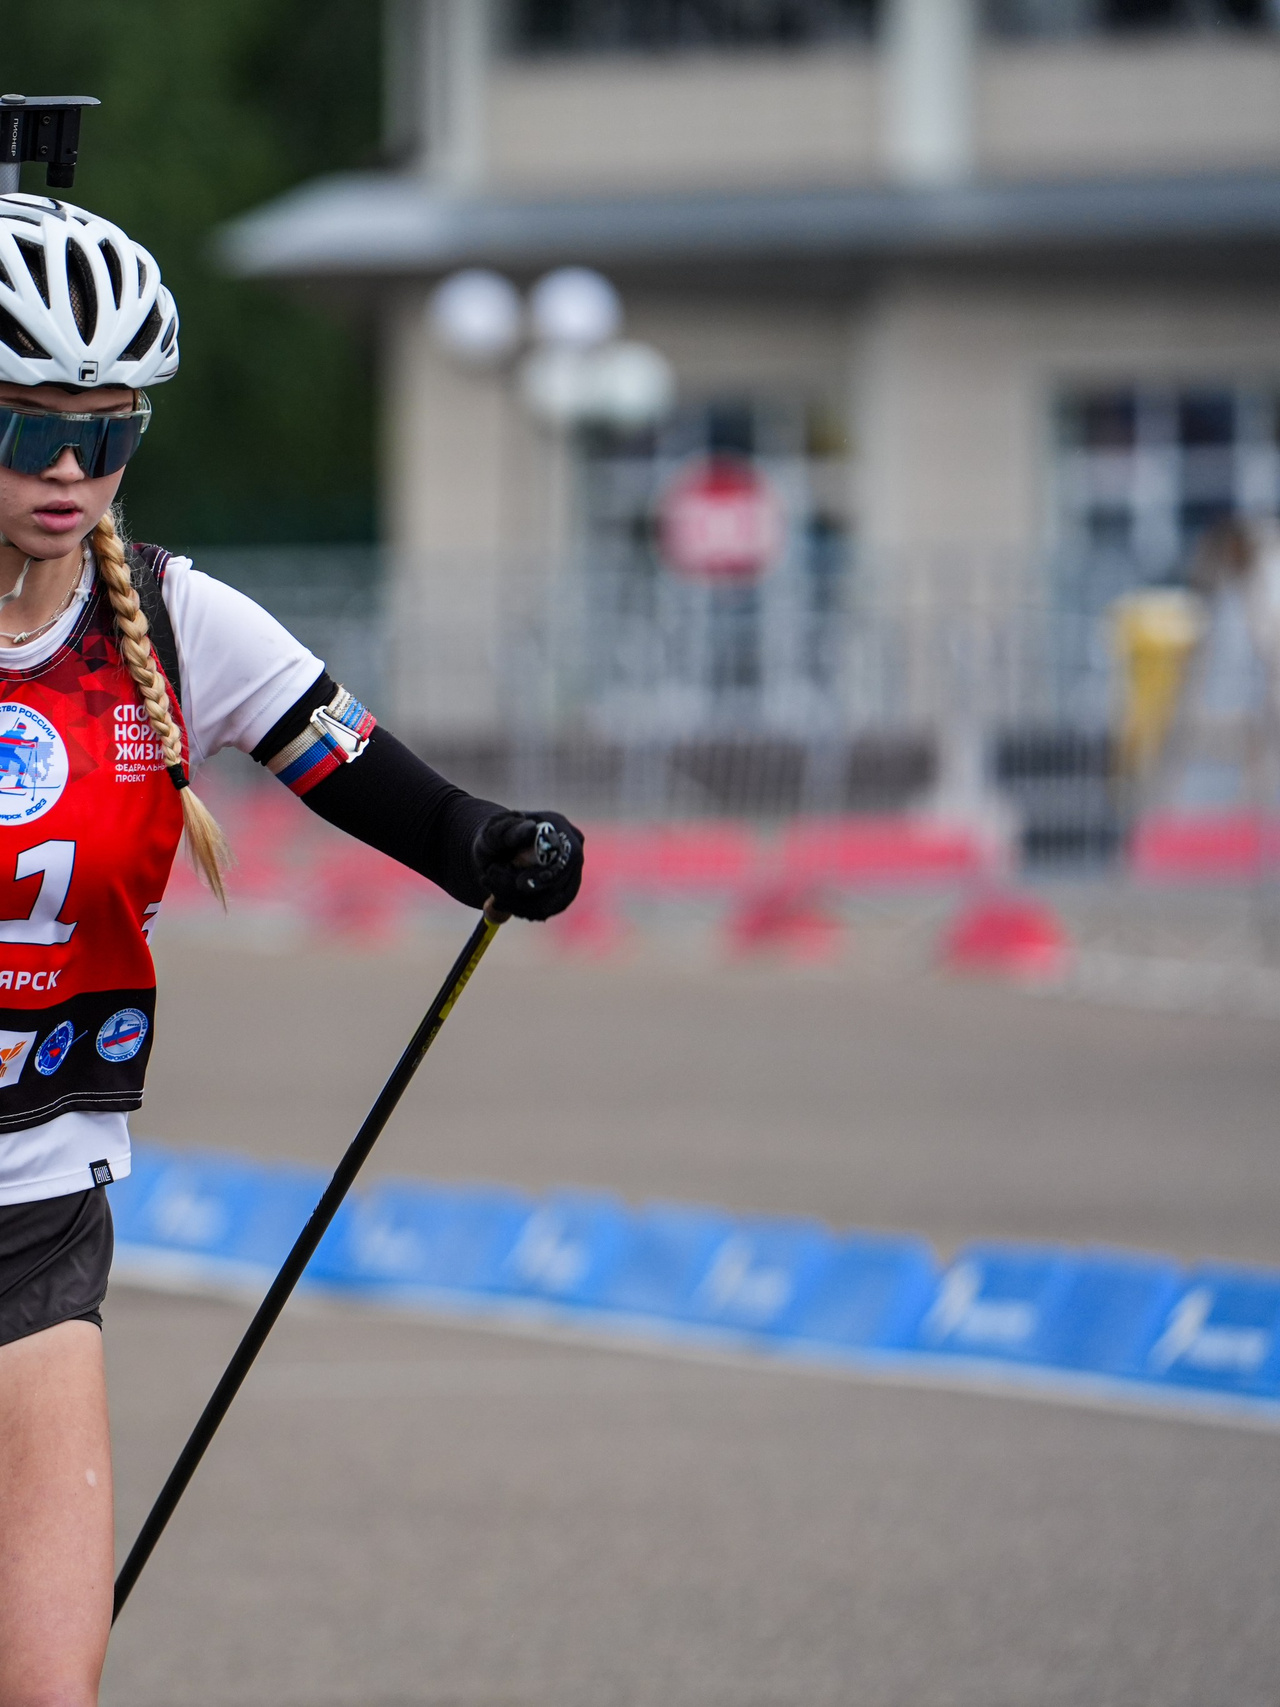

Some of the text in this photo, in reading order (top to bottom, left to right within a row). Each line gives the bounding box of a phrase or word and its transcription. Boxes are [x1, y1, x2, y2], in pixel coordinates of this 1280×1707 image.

[11, 118, 19, 157] ПИОНЕР
[113, 704, 149, 722] СПО
[18, 707, 57, 740] РОССИИ
[115, 743, 165, 760] ЖИЗН
[115, 774, 146, 783] ПРОЕКТ
[25, 797, 47, 817] 2023
